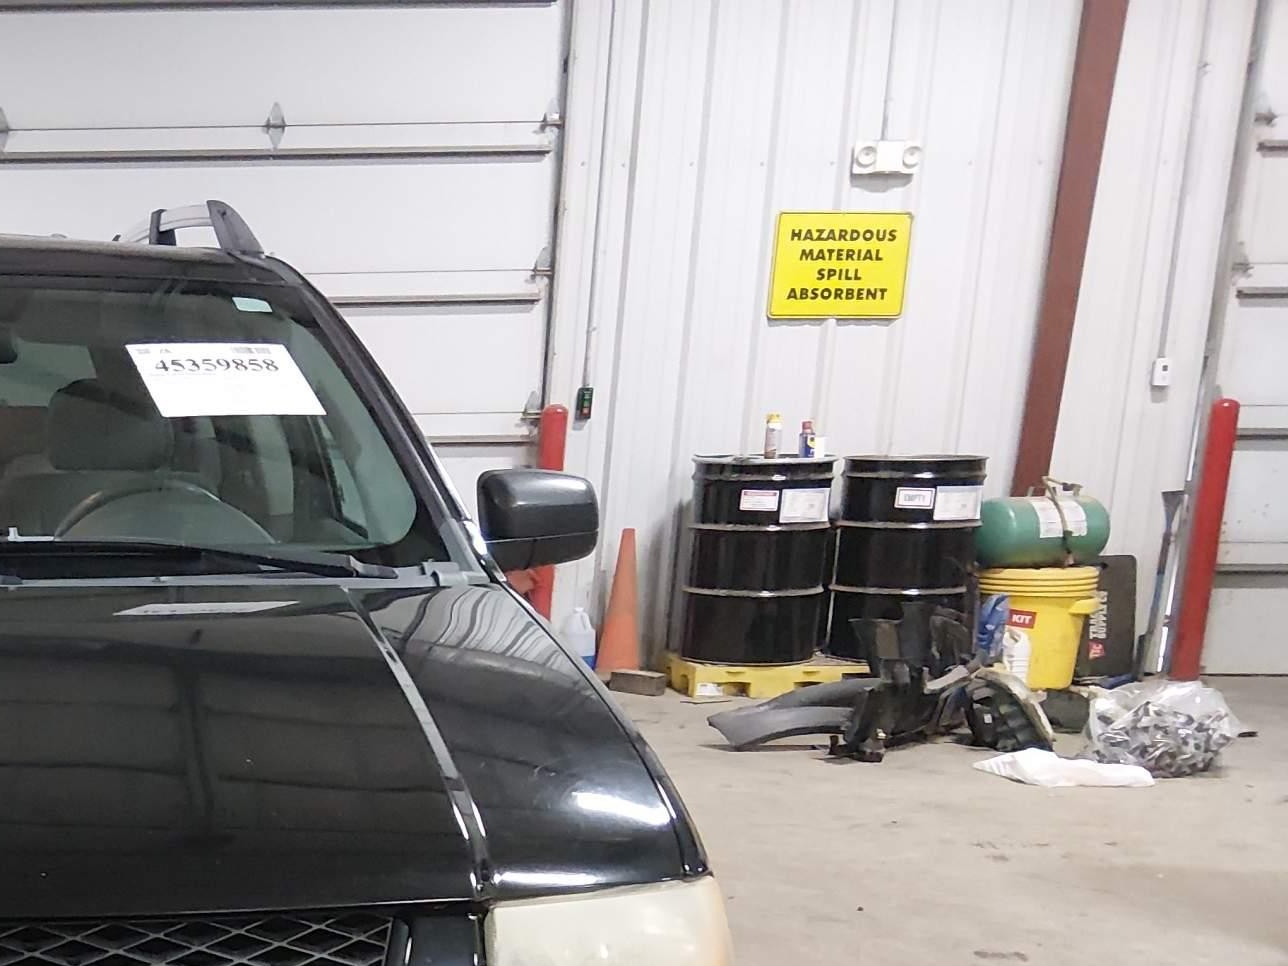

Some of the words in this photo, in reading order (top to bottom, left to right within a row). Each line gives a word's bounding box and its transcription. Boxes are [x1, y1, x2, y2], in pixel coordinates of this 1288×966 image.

[790, 228, 898, 242] HAZARDOUS
[799, 248, 884, 261] MATERIAL
[816, 268, 862, 281] SPILL
[786, 287, 888, 300] ABSORBENT
[155, 358, 280, 372] 45359858
[1012, 614, 1033, 625] KIT
